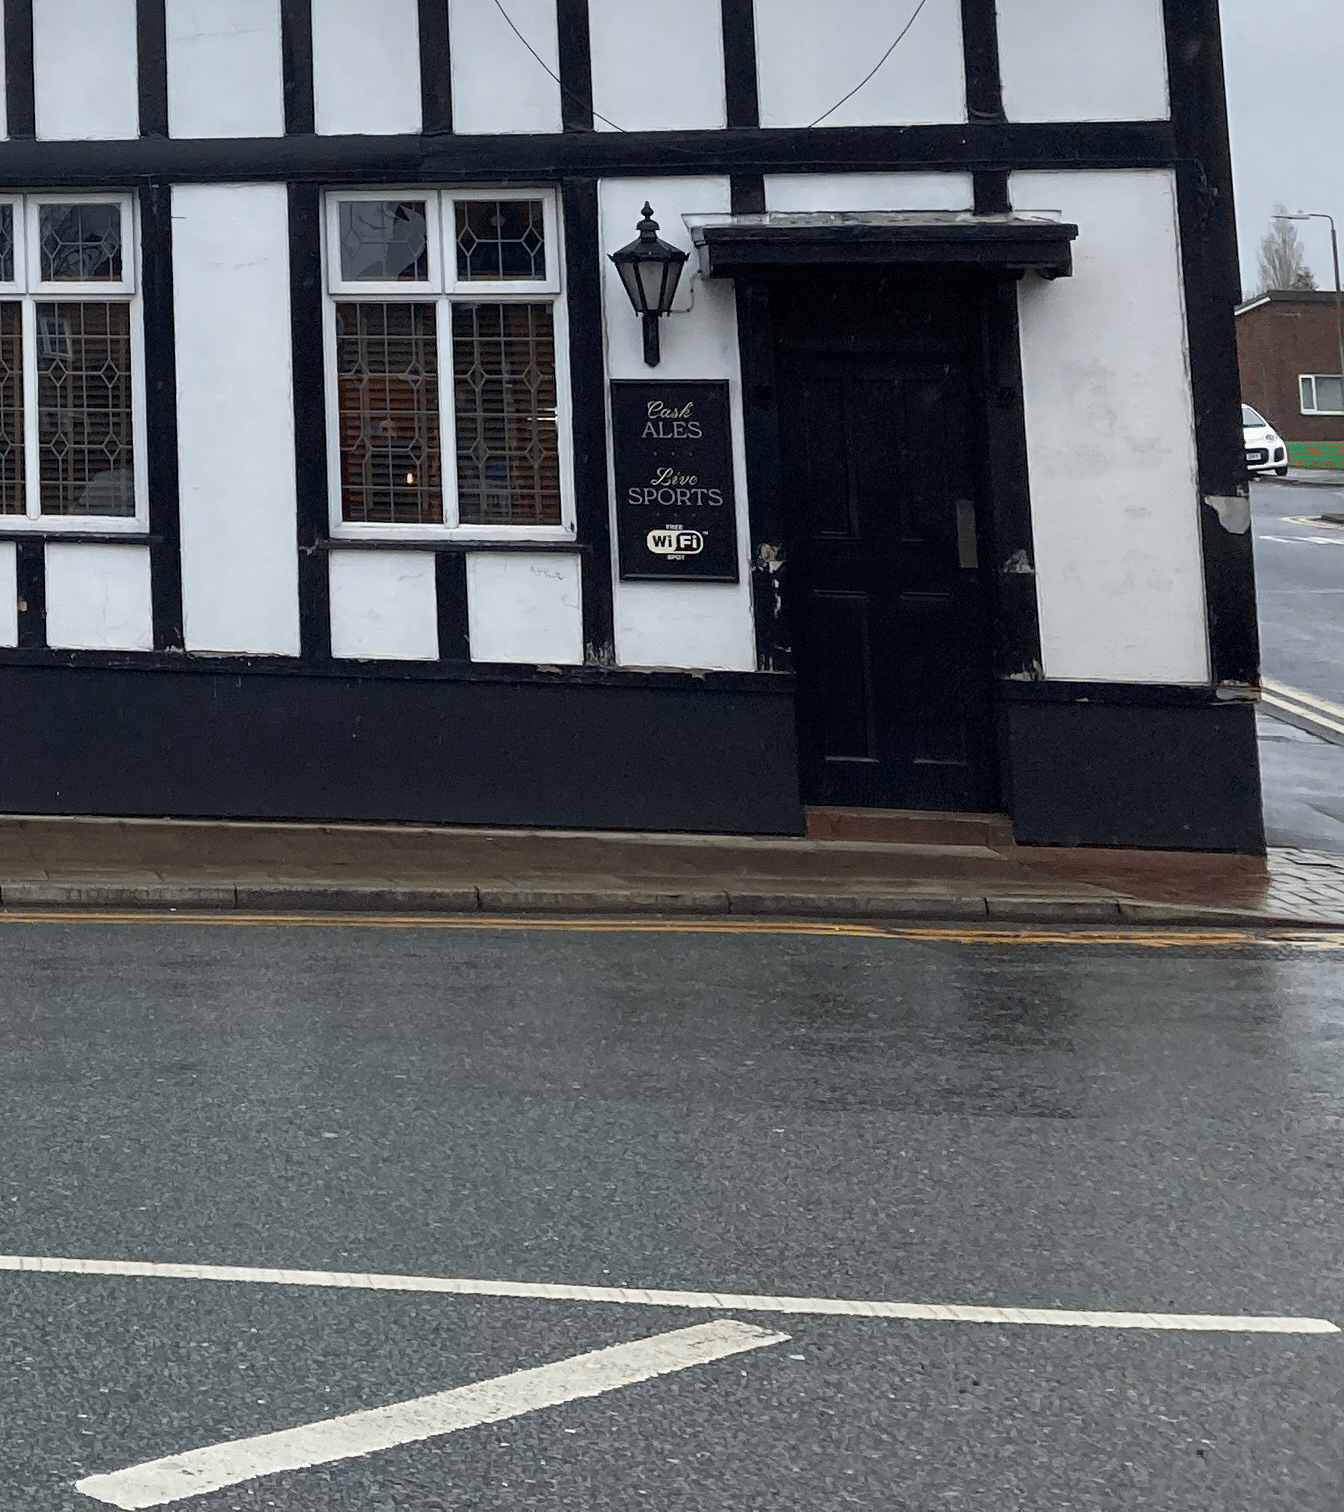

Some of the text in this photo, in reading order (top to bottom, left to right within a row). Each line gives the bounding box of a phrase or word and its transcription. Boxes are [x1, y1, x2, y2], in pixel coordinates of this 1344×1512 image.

[647, 400, 694, 419] Cask
[641, 421, 703, 439] ALES
[650, 467, 698, 486] Live
[628, 488, 723, 506] SPORTS
